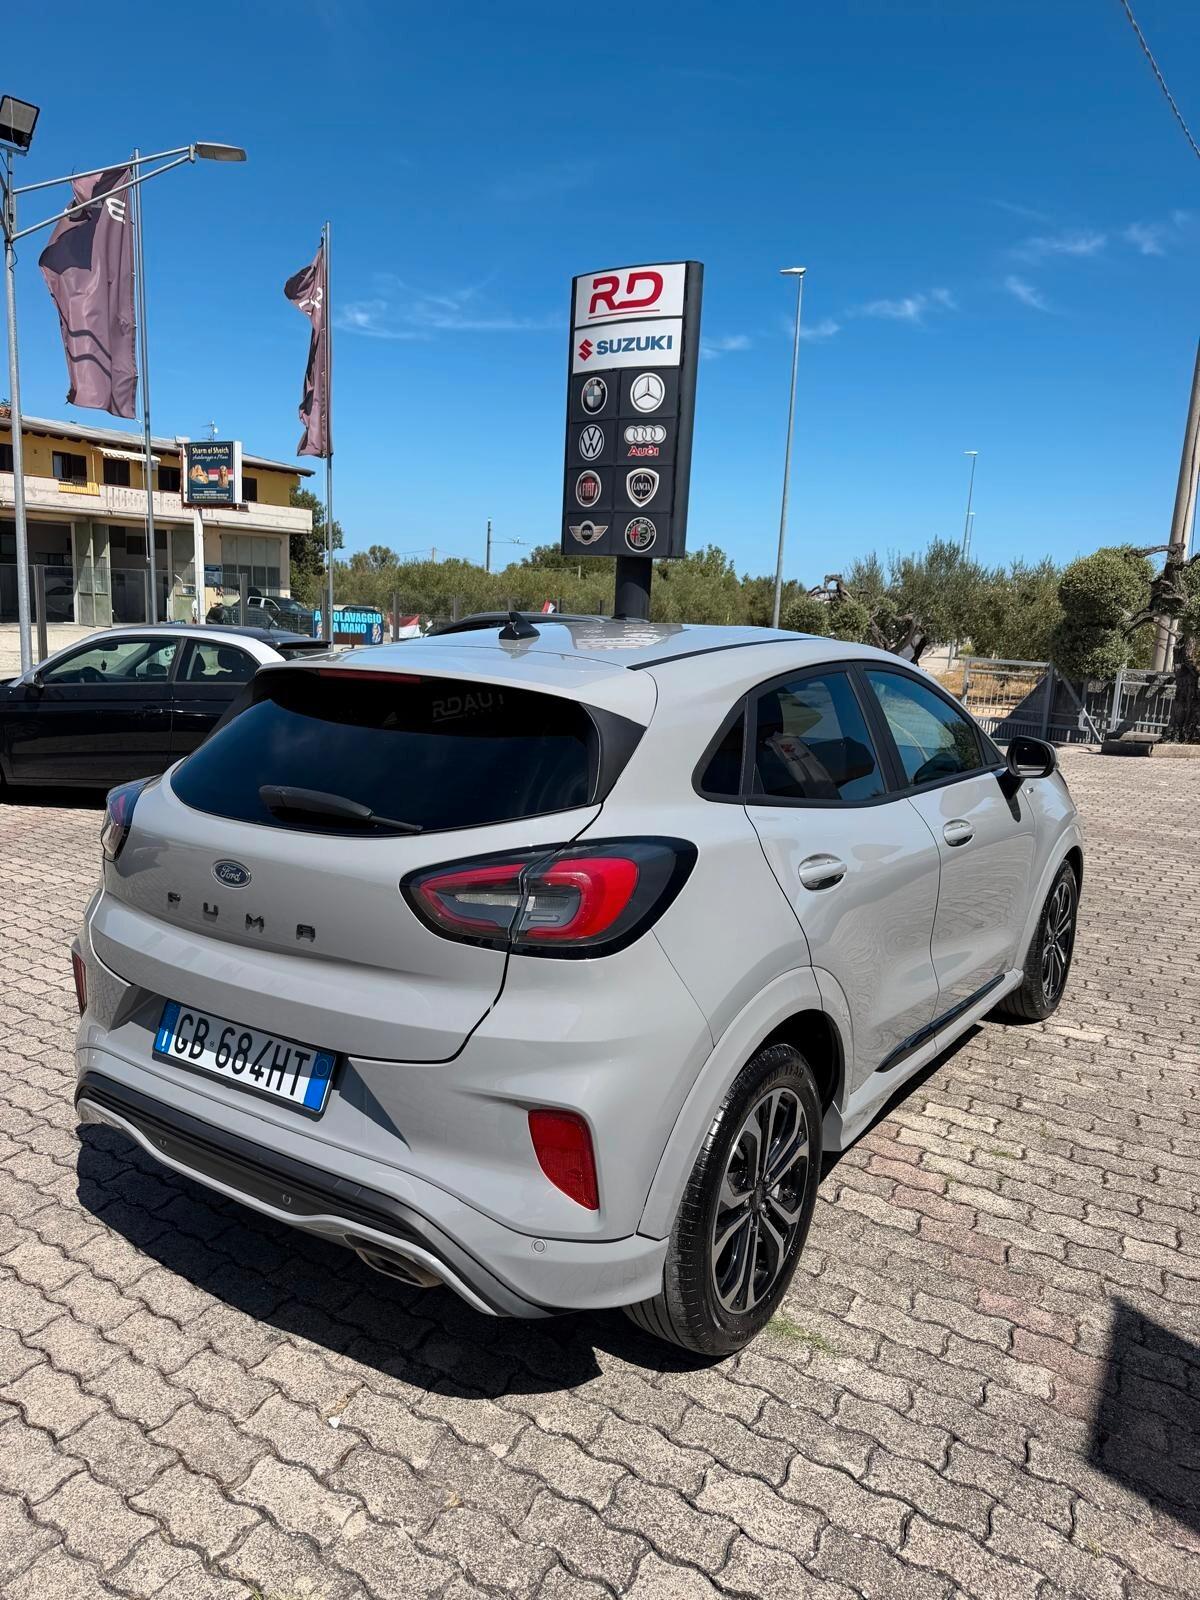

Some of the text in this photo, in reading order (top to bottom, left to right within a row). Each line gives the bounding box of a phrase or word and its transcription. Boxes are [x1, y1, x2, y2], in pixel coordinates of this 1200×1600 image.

[589, 271, 664, 313] RD
[596, 335, 673, 355] SUZUKI
[627, 445, 660, 457] Audi
[582, 482, 596, 497] FIAT
[633, 482, 651, 491] LANCIA
[314, 611, 382, 624] AOLAVAGGIO
[333, 623, 367, 634] A MANO
[220, 865, 242, 882] Ford
[167, 891, 316, 938] PUMA
[174, 1013, 210, 1060] GB
[214, 1026, 311, 1097] 684HT
